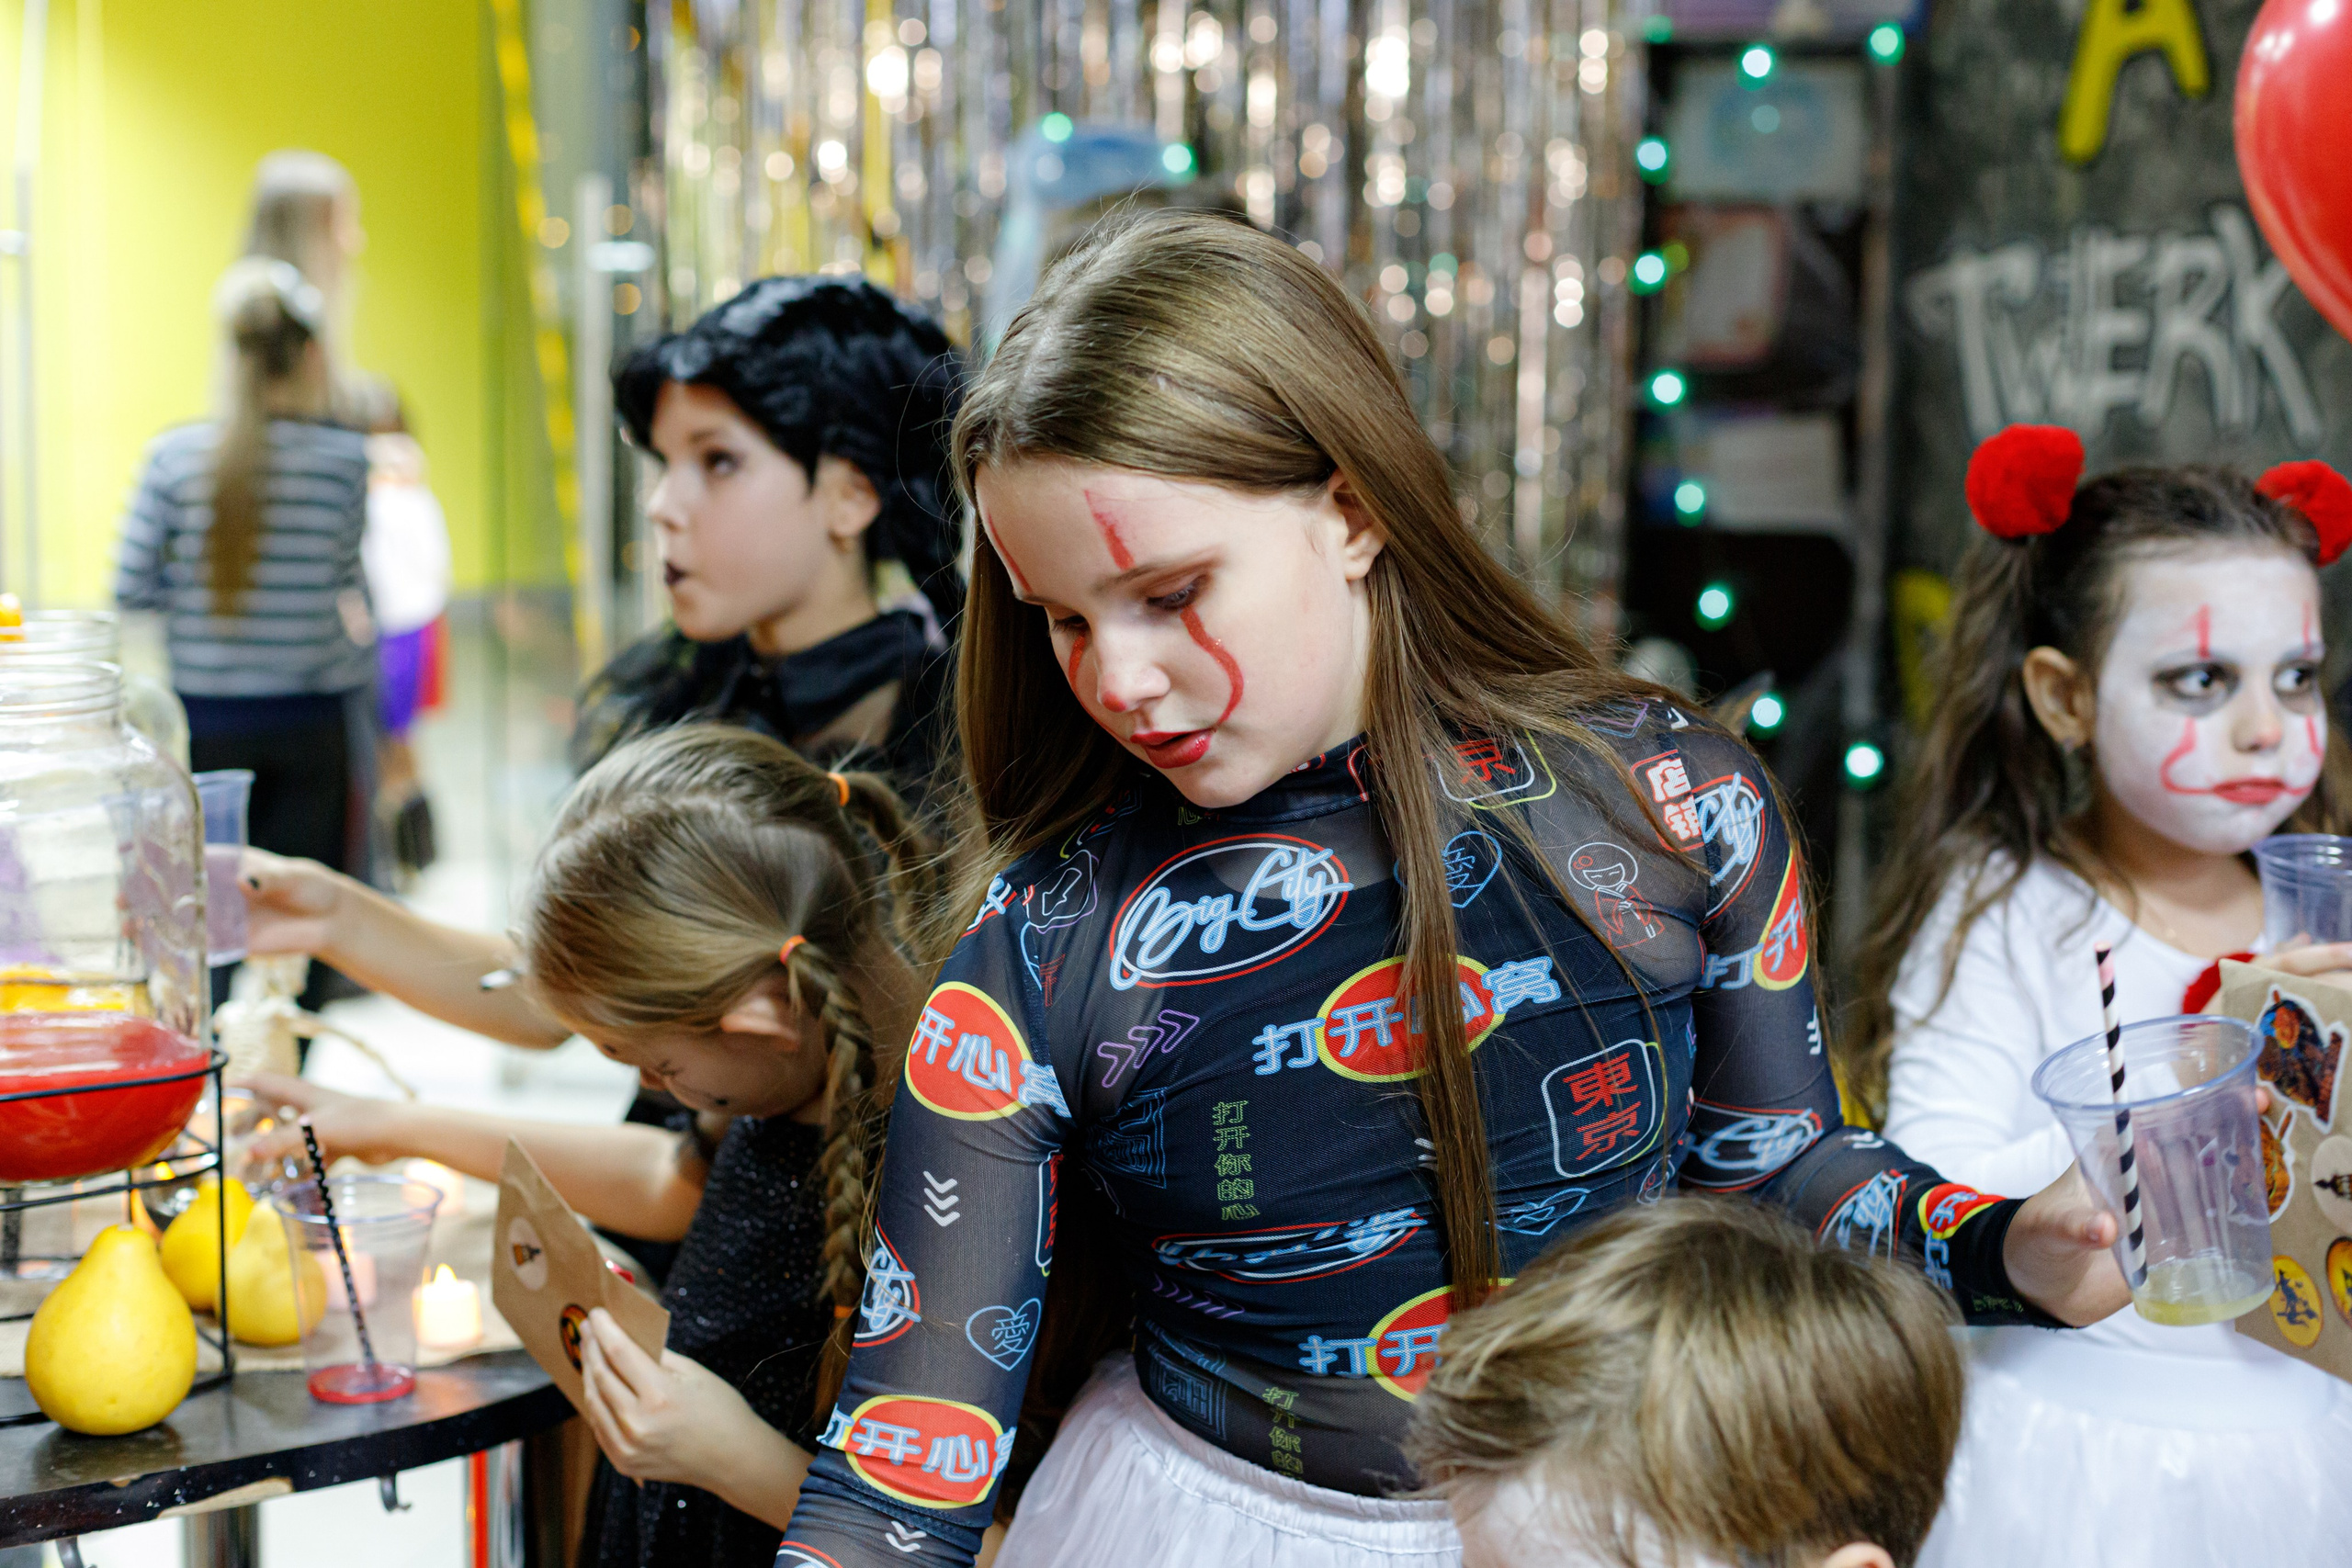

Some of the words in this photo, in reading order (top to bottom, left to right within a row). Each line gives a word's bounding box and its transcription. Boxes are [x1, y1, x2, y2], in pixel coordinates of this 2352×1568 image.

[1907, 204, 2324, 448] TWERK
[1110, 886, 1240, 991] Big
[1238, 847, 1355, 931] City
[1564, 1053, 1640, 1161] 東京
